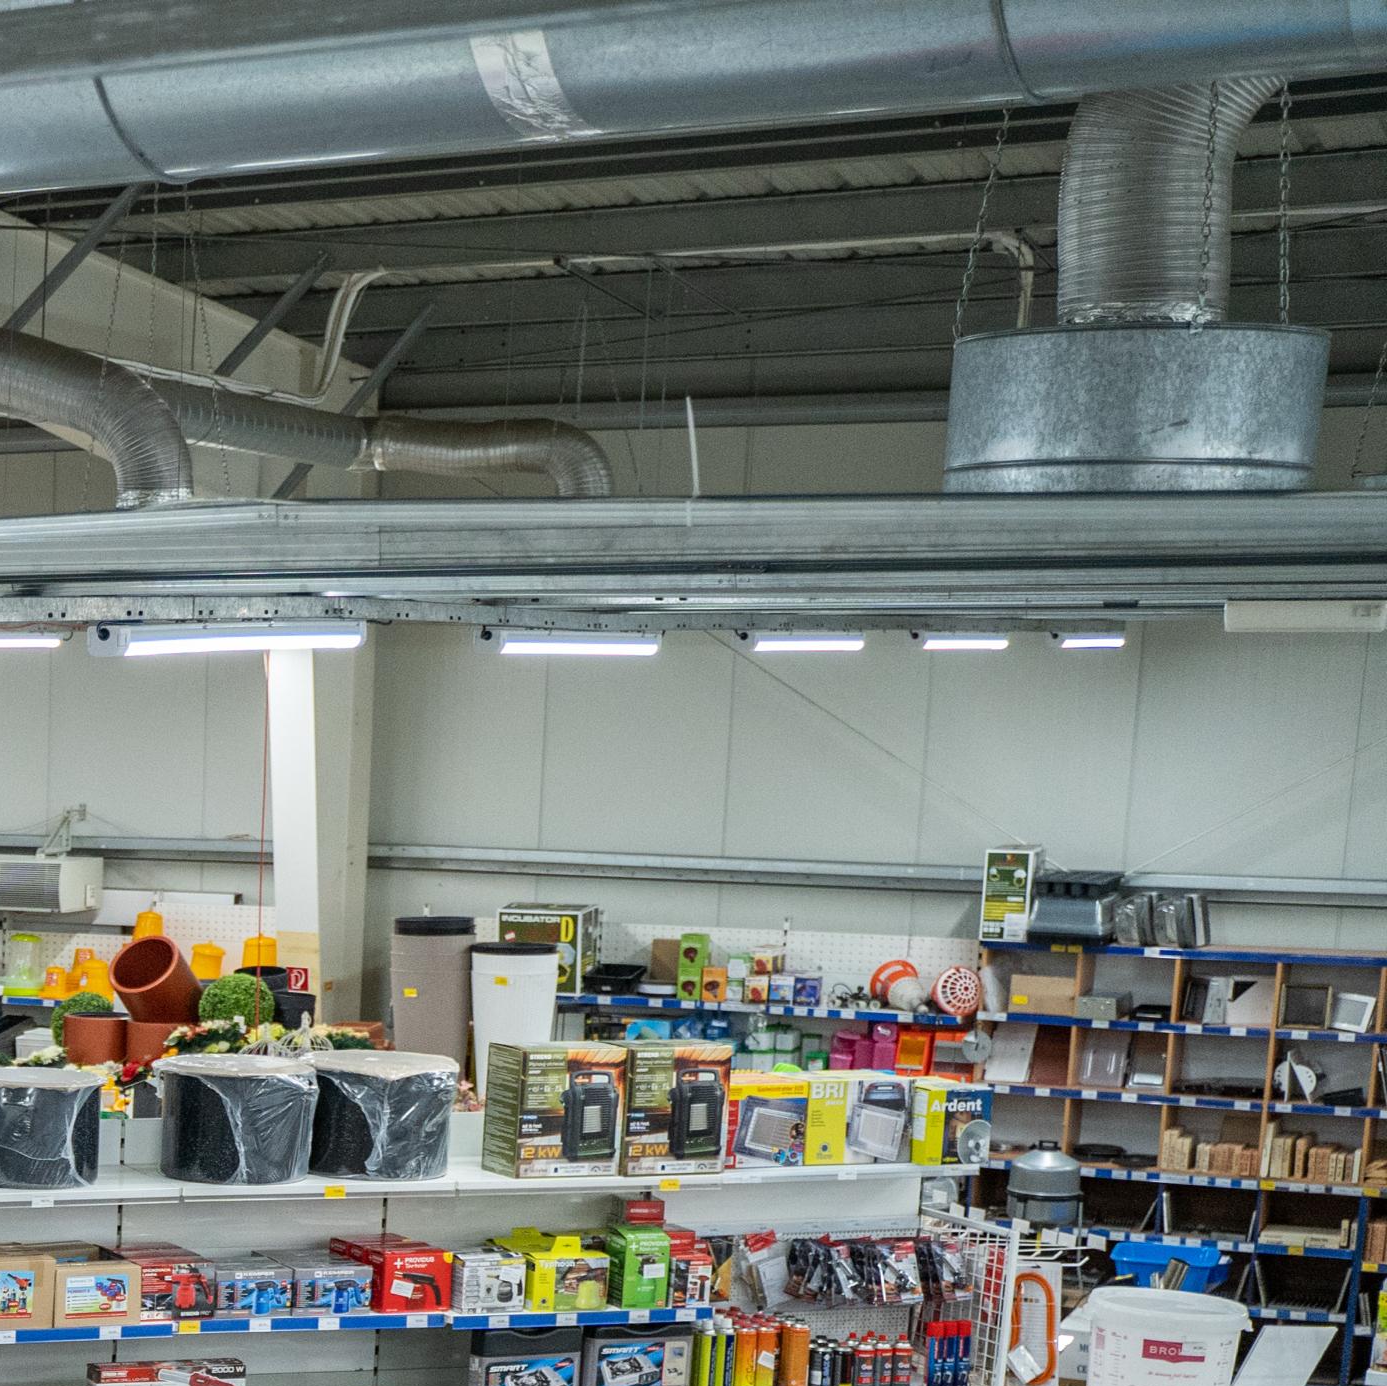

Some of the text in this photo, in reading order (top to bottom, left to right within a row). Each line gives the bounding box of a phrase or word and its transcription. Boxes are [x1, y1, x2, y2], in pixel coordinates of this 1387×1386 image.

[931, 1099, 982, 1113] Ardent
[537, 1145, 562, 1158] kW
[601, 1346, 640, 1354] SMART
[211, 1365, 244, 1374] 2000 W
[489, 1364, 528, 1372] SMART
